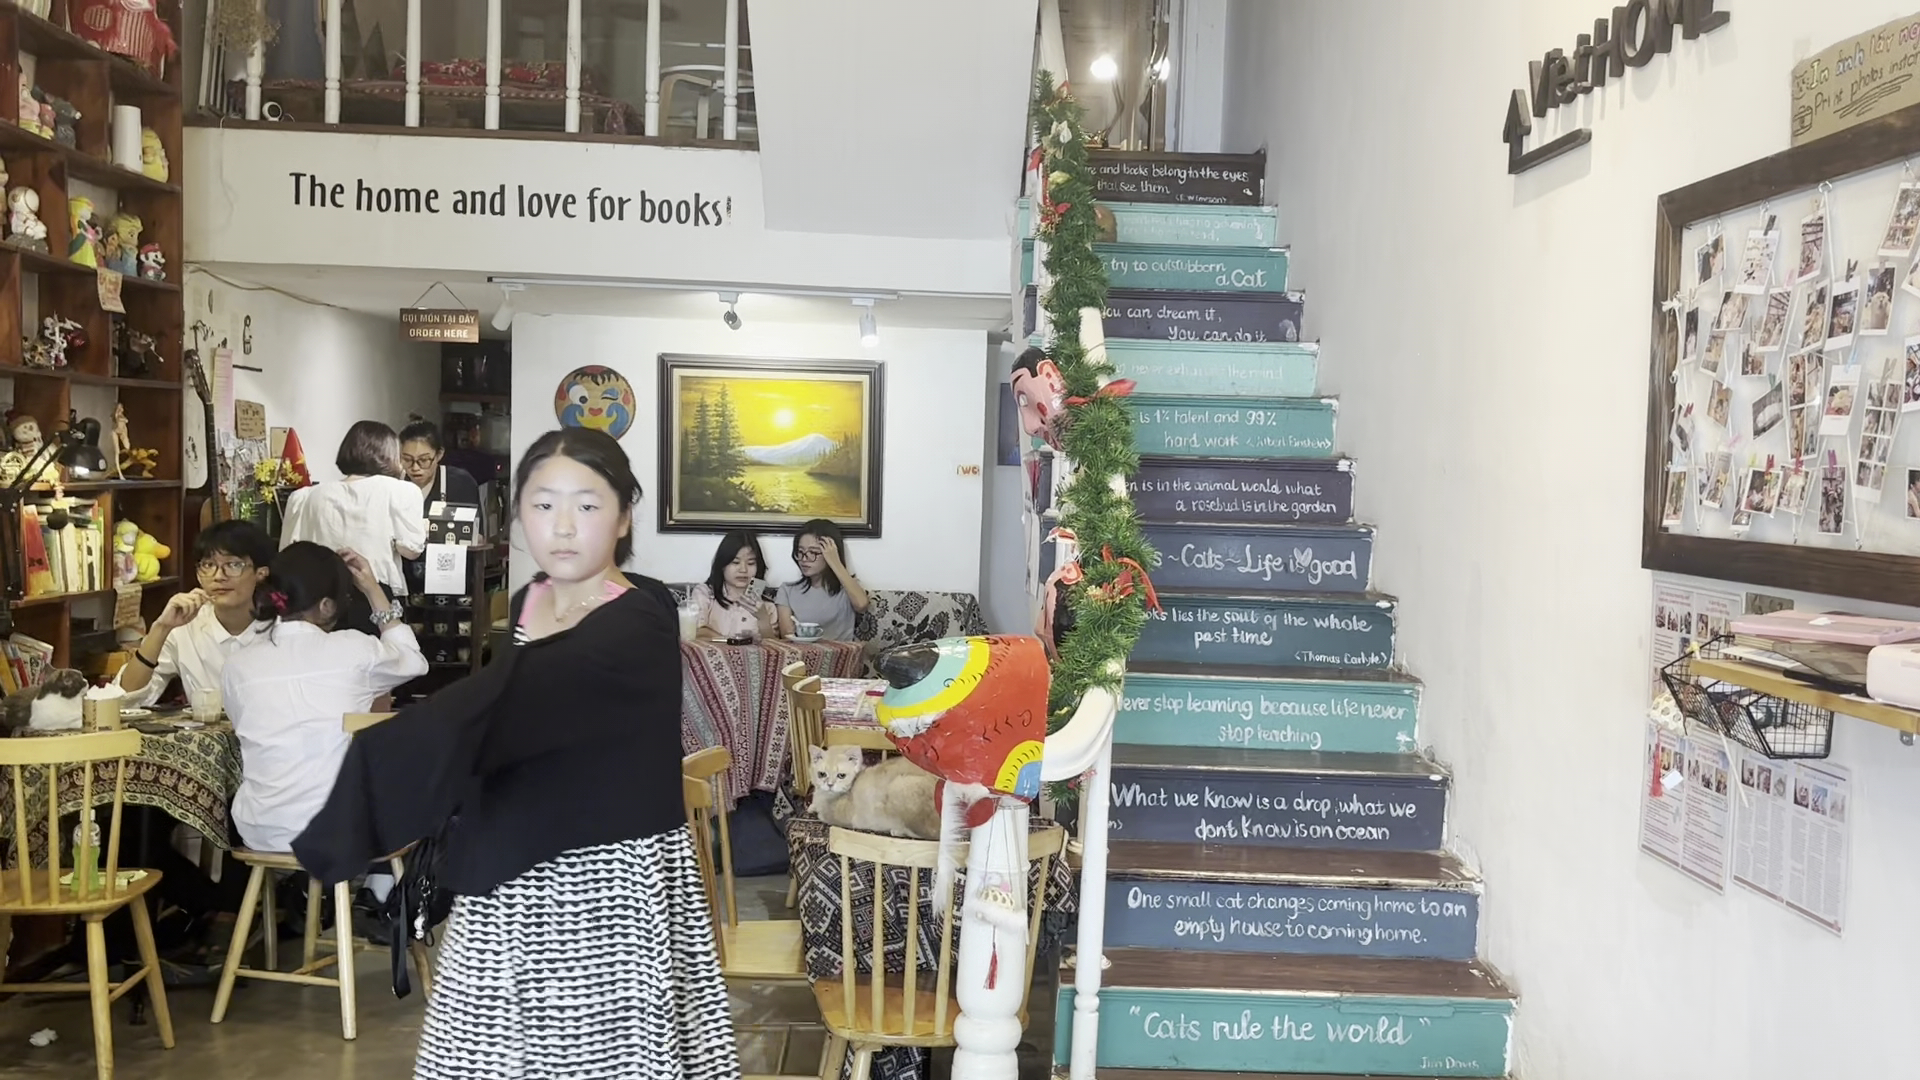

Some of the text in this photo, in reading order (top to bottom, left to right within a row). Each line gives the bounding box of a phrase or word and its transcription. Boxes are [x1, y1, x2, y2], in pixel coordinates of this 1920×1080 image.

[1099, 162, 1120, 175] and
[1123, 163, 1149, 176] books
[1152, 163, 1187, 184] belong
[1200, 166, 1220, 179] the
[1223, 169, 1250, 183] eyes
[289, 172, 345, 208] The
[356, 178, 440, 213] home
[453, 184, 505, 216] and
[518, 184, 577, 219] love
[587, 187, 632, 222] for
[1119, 181, 1137, 192] see
[1140, 180, 1171, 194] them
[1111, 257, 1128, 275] try
[1132, 260, 1148, 271] to
[1215, 268, 1267, 288] a Cat
[1127, 307, 1152, 319] can
[1157, 305, 1200, 320] dream
[409, 328, 468, 338] ORDER HERE
[1168, 325, 1199, 340] You
[1203, 329, 1232, 341] can
[1234, 327, 1252, 341] do
[1139, 409, 1277, 426] is 1% talent and 99%
[1164, 431, 1201, 449] hard
[1205, 434, 1240, 447] work
[1142, 480, 1153, 492] is
[1157, 479, 1170, 491] in
[1173, 477, 1192, 491] the
[1194, 479, 1240, 492] animal
[1241, 478, 1282, 495] world
[1285, 480, 1322, 496] what
[1176, 499, 1188, 510] a
[1241, 499, 1252, 512] is
[1254, 499, 1268, 512] in
[1268, 499, 1289, 513] the
[1291, 500, 1337, 520] garden
[1237, 543, 1284, 582] Life
[1308, 550, 1358, 585] good
[1172, 607, 1194, 622] lies
[1196, 608, 1220, 622] the
[1222, 610, 1260, 624] soul
[1264, 614, 1277, 631] of
[1284, 612, 1308, 626] the
[1313, 613, 1373, 632] whole
[1194, 626, 1273, 650] past time
[1153, 692, 1184, 715] stop
[1187, 691, 1254, 720] learning
[1260, 694, 1329, 717] because
[1331, 699, 1359, 718] life
[1361, 701, 1409, 720] never
[1218, 723, 1254, 746] stop
[1111, 782, 1168, 807] What
[1174, 791, 1199, 807] we
[1256, 794, 1270, 810] is
[1274, 796, 1289, 810] a
[1339, 793, 1386, 816] what
[1389, 802, 1417, 818] we
[1292, 818, 1308, 838] is
[1309, 825, 1333, 839] an
[1335, 825, 1390, 840] ocean
[1127, 886, 1467, 921] One small cat changes coming home to an
[1174, 915, 1225, 942] empty
[1229, 916, 1283, 937] house
[1285, 917, 1304, 938] to
[1307, 923, 1373, 946] coming
[1212, 1009, 1263, 1041] rule
[1271, 1012, 1316, 1042] the
